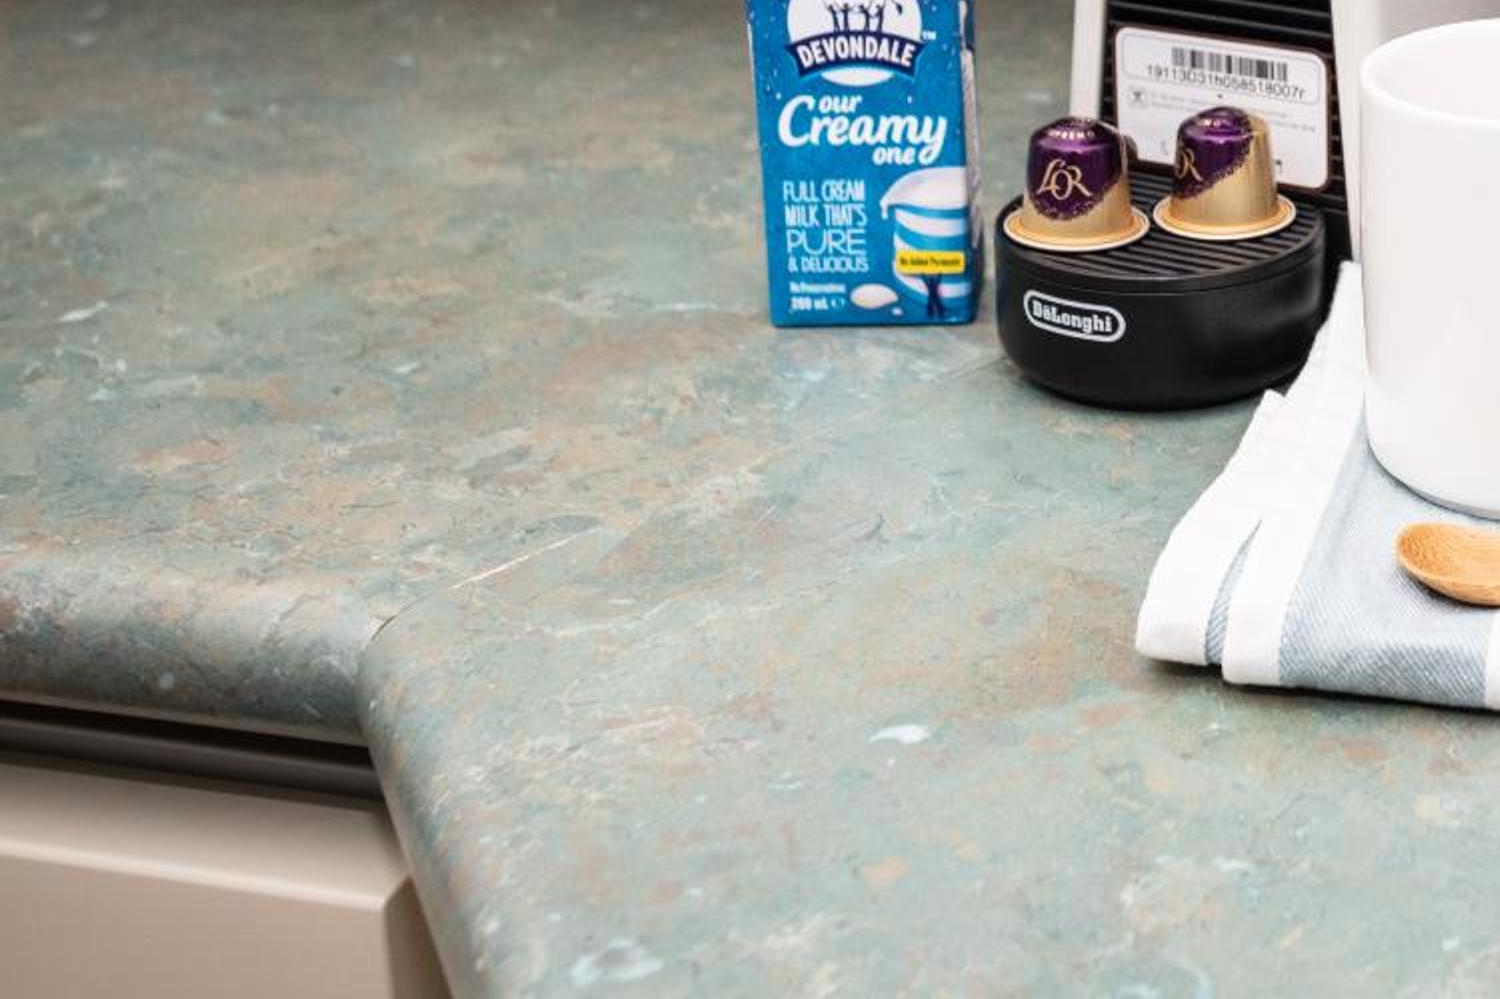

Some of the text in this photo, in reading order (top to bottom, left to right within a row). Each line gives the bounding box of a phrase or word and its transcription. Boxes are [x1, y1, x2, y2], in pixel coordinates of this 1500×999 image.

[796, 34, 916, 69] DEVONDALE
[817, 95, 863, 114] our
[778, 94, 948, 165] Creamy
[872, 146, 916, 166] one
[783, 179, 865, 203] FULL CREAM
[785, 203, 820, 228] MILK
[786, 228, 867, 255] PURE
[787, 256, 869, 273] & DELICIOUS
